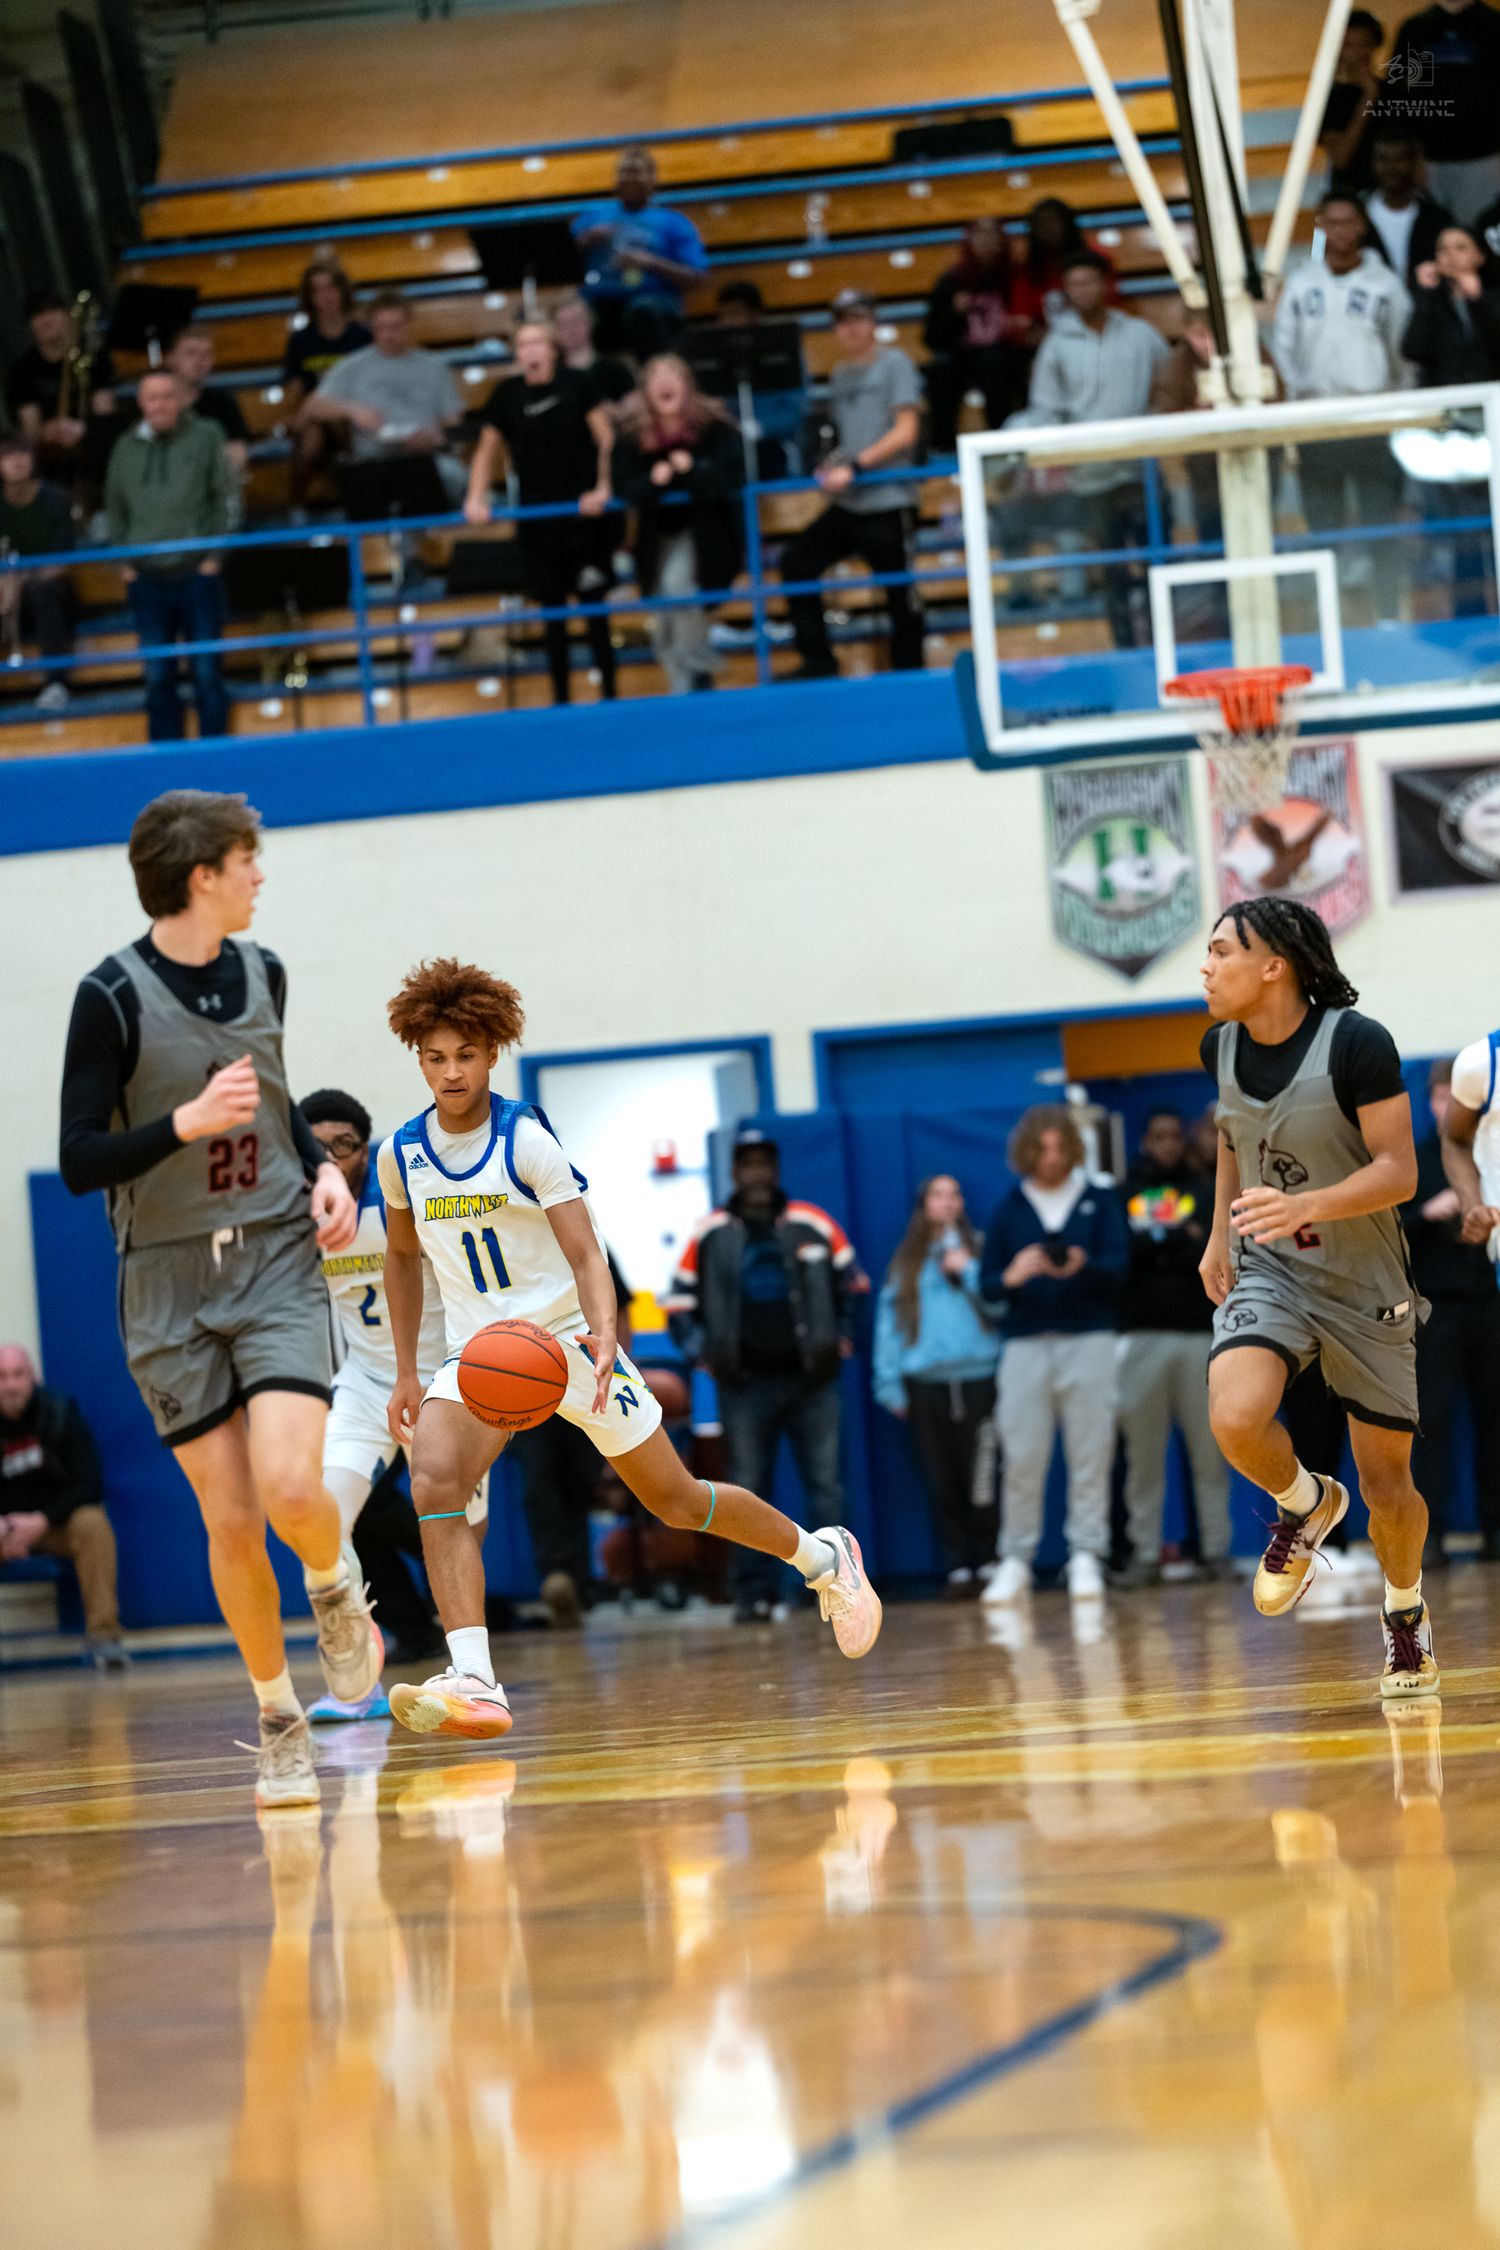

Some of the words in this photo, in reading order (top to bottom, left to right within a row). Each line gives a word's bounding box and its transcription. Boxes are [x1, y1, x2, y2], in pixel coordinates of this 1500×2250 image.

[208, 1133, 258, 1193] 23
[424, 1193, 509, 1222] NORTHWEST
[461, 1226, 512, 1294] 11
[350, 1283, 382, 1326] 2
[467, 1406, 534, 1429] Rawlings
